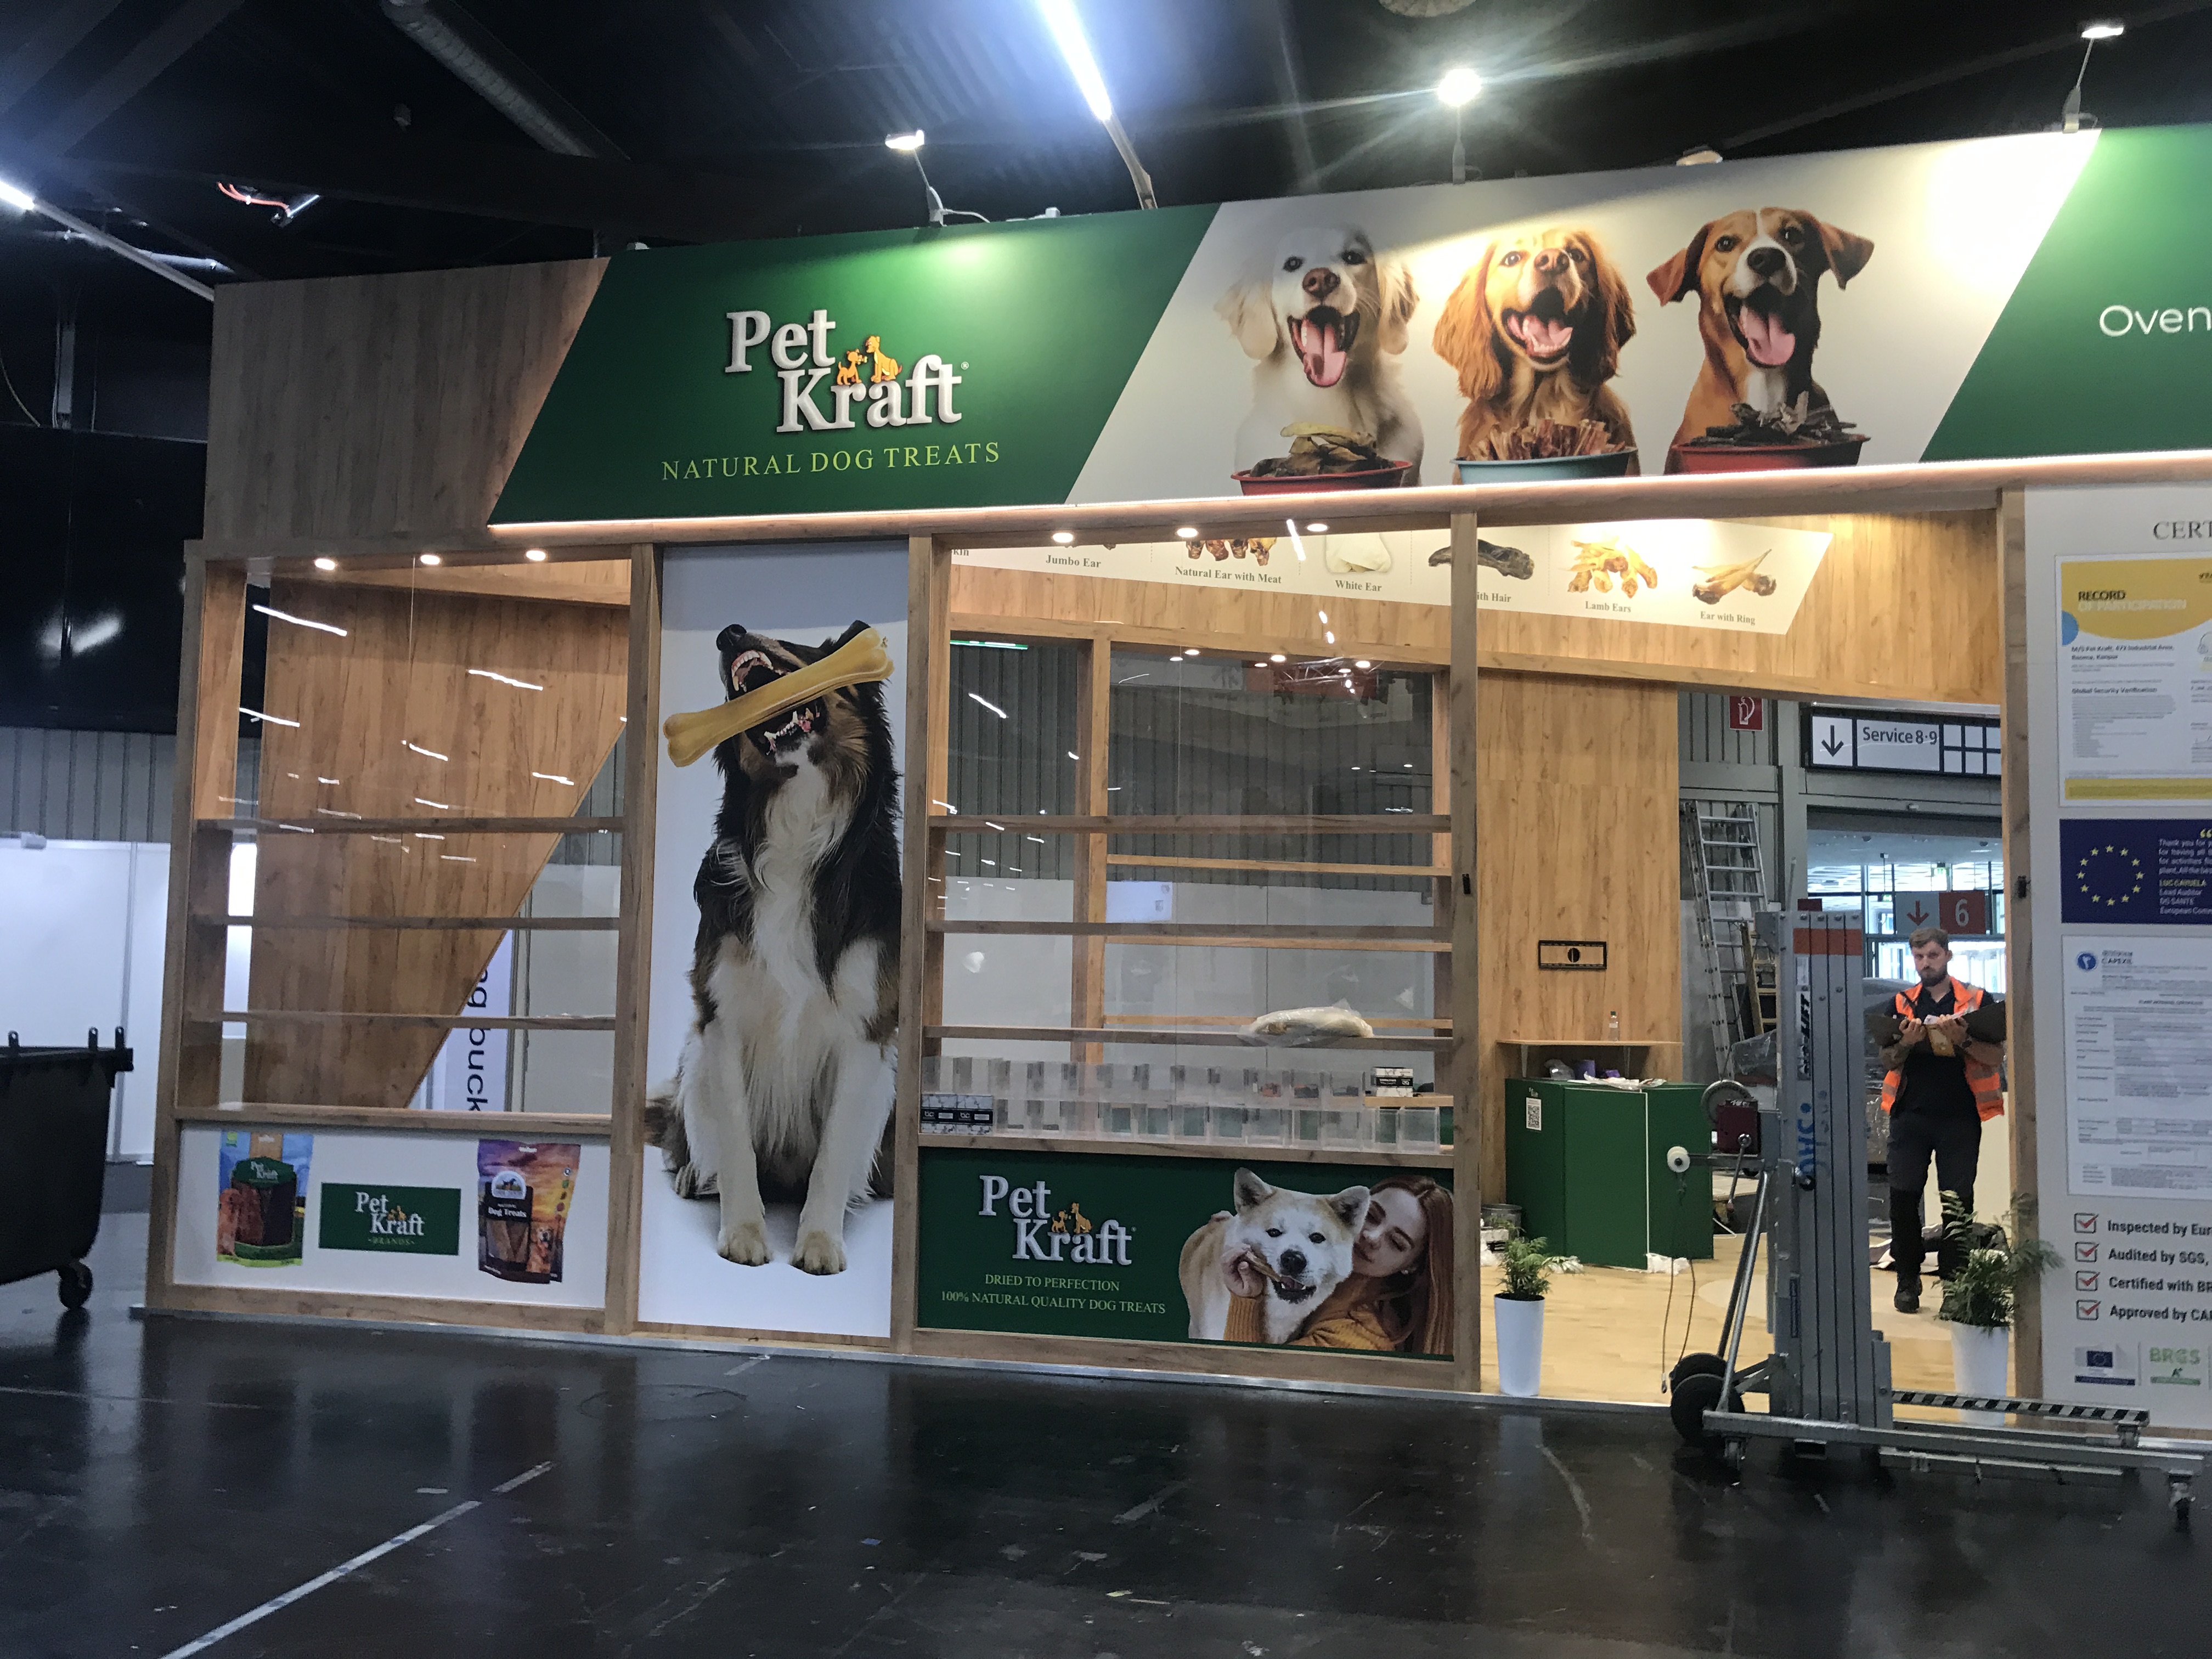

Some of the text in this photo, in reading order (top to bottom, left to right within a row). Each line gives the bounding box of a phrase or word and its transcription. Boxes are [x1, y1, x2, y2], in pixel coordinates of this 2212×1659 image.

[2100, 304, 2211, 337] Oven
[725, 309, 836, 373] Pet
[661, 441, 1000, 481] NATURAL DOG TREATS
[1046, 554, 1101, 568] Jumbo Ear
[1175, 566, 1282, 584] Natural Ear with Meat
[1335, 580, 1382, 591] White Ear
[1476, 591, 1511, 602] ith Hair
[2078, 590, 2126, 601] RECORD
[1585, 601, 1631, 612] Lamb Ears
[1700, 611, 1756, 625] Ear with Ring
[1863, 726, 1913, 743] Service
[1954, 898, 1970, 927] 6
[354, 1191, 389, 1214] Pet
[978, 1174, 1051, 1218] Pet
[488, 1206, 527, 1217] Dog Treats
[369, 1213, 425, 1235] Kraft
[2107, 1220, 2169, 1235] Inspected
[2172, 1222, 2187, 1237] by
[2108, 1248, 2157, 1262] Audited
[2160, 1250, 2175, 1265] by
[985, 1274, 1120, 1291] DRIED TO PERFECTION
[2109, 1276, 2163, 1291] Certified
[2167, 1280, 2193, 1292] with
[941, 1291, 1165, 1314] 100% NATURAL QUALITY DOG TREATS
[2110, 1305, 2169, 1320] Approved
[2172, 1307, 2187, 1323] by
